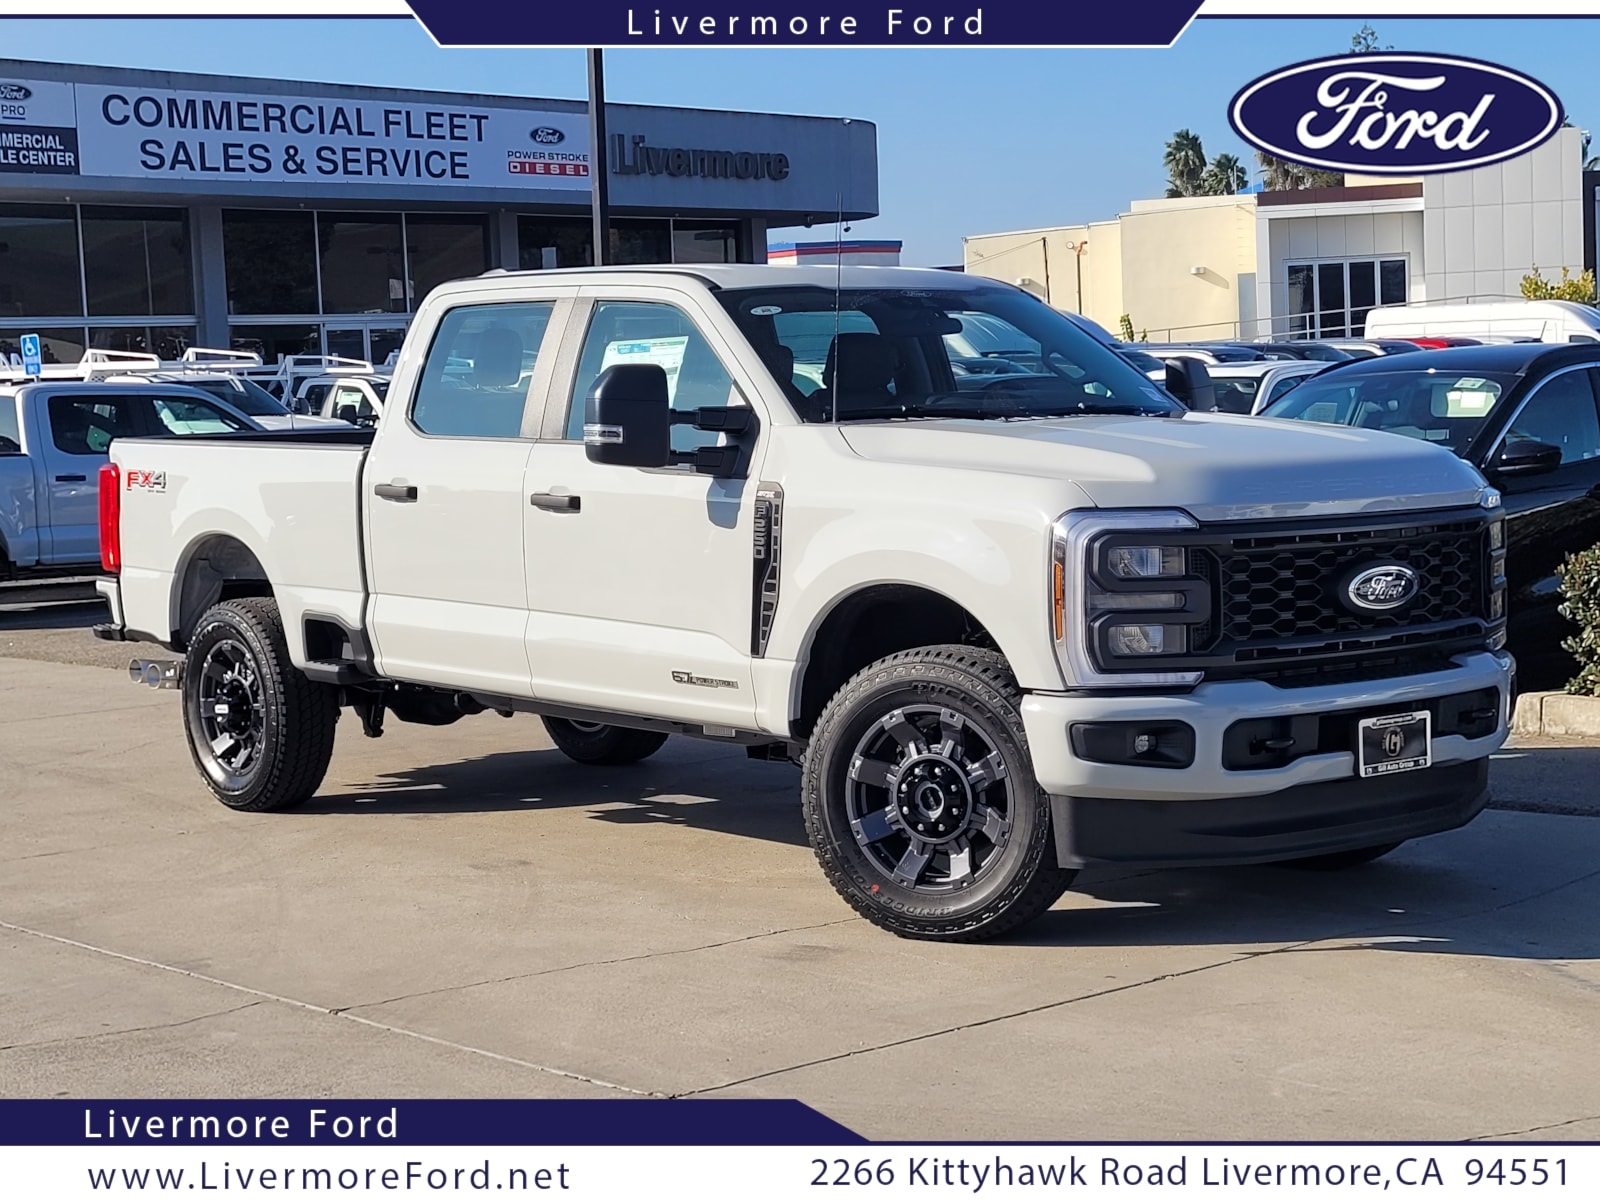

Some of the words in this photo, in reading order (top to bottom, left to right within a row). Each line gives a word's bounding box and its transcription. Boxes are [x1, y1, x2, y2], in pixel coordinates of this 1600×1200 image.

[0, 86, 26, 99] Ford
[1, 104, 26, 116] PRO
[102, 94, 375, 137] COMMERCIAL
[383, 109, 489, 142] FLEET
[0, 132, 65, 150] MERCIAL
[535, 127, 560, 143] Ford
[0, 149, 17, 164] LE
[19, 150, 75, 166] CENTER
[140, 139, 273, 174] SALES
[282, 144, 308, 175] &
[315, 145, 470, 180] SERVICE
[507, 150, 546, 160] POWER
[547, 152, 589, 162] STROKE
[611, 133, 790, 181] Livermore
[509, 162, 588, 176] DIESEL
[126, 469, 167, 491] FX4
